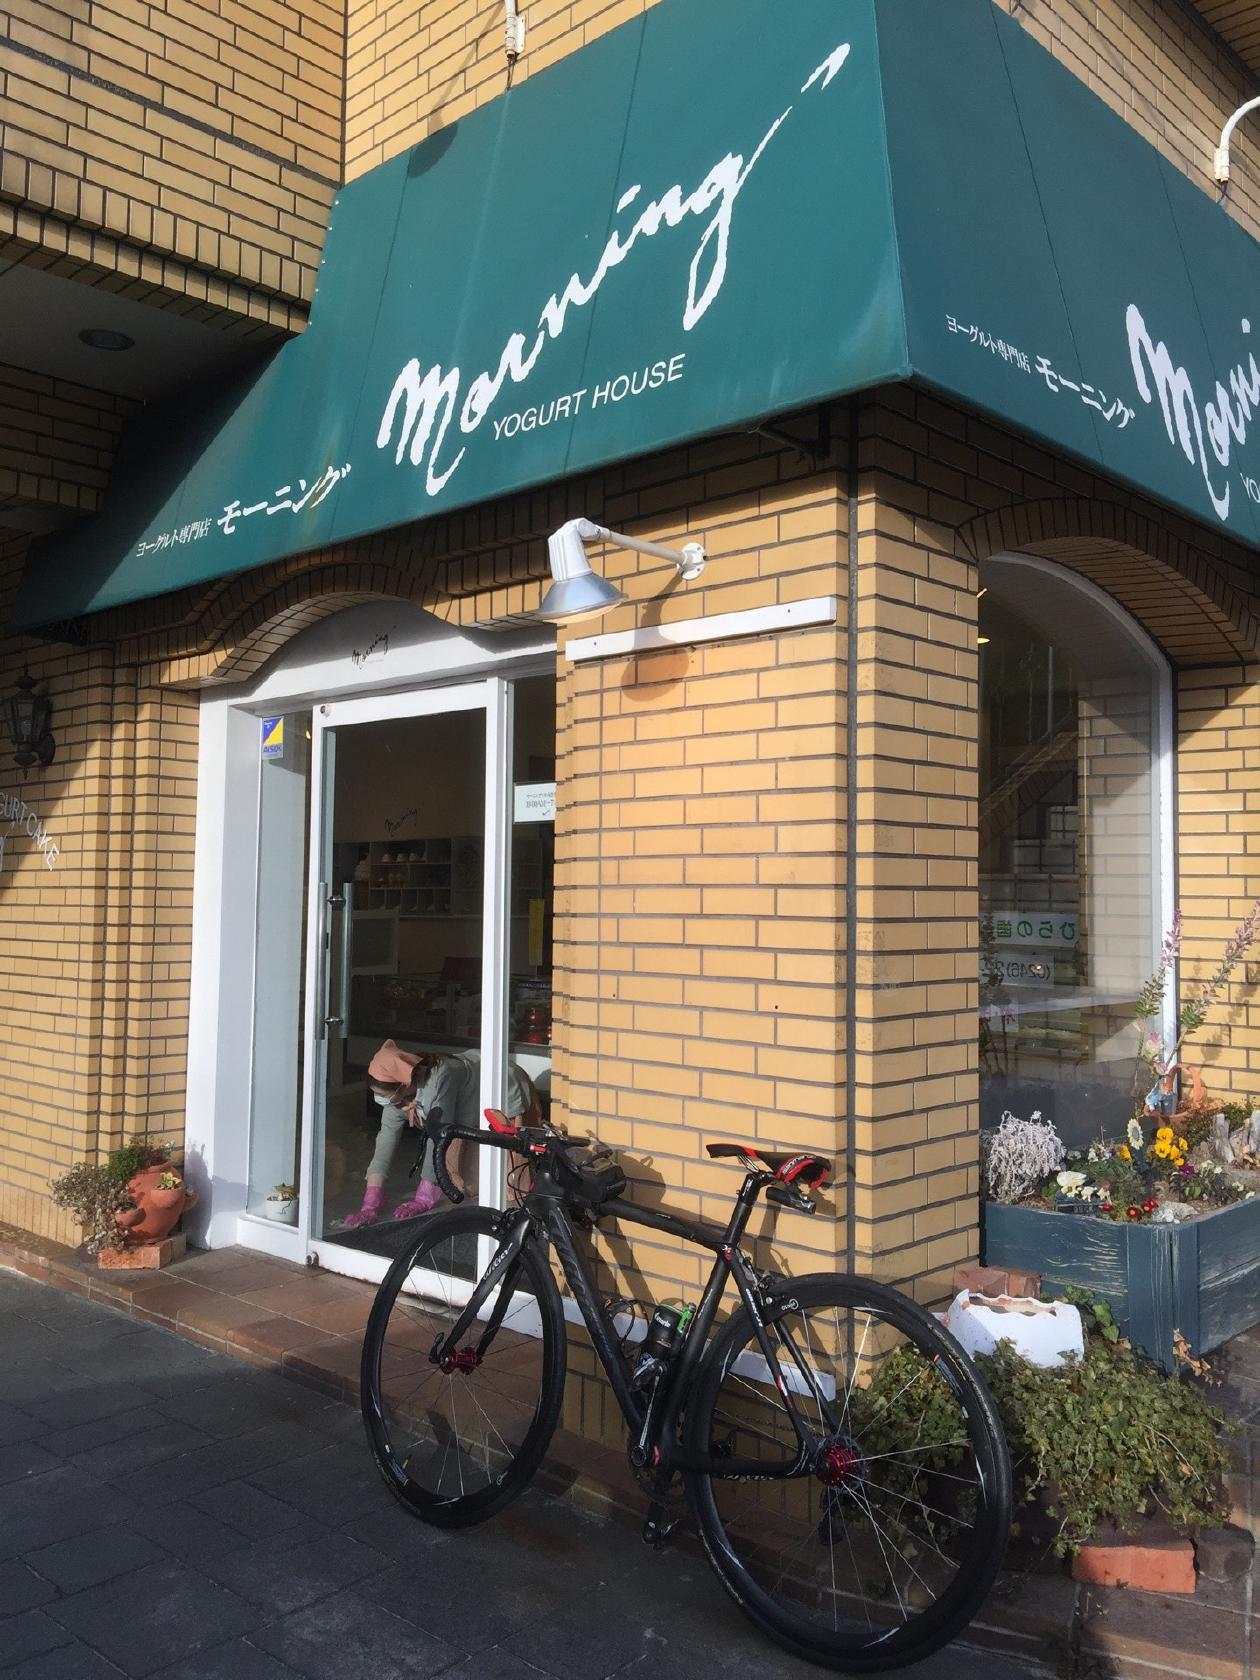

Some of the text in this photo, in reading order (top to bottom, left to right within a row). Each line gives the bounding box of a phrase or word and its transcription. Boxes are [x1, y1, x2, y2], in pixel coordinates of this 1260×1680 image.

[377, 105, 793, 496] Morning
[493, 353, 686, 441] YOGURT HOUSE
[946, 314, 1136, 429] ヨーグルト専門店 モーニング
[136, 463, 352, 557] ヨーグルト専門店 モーニング
[27, 812, 60, 872] CAKE
